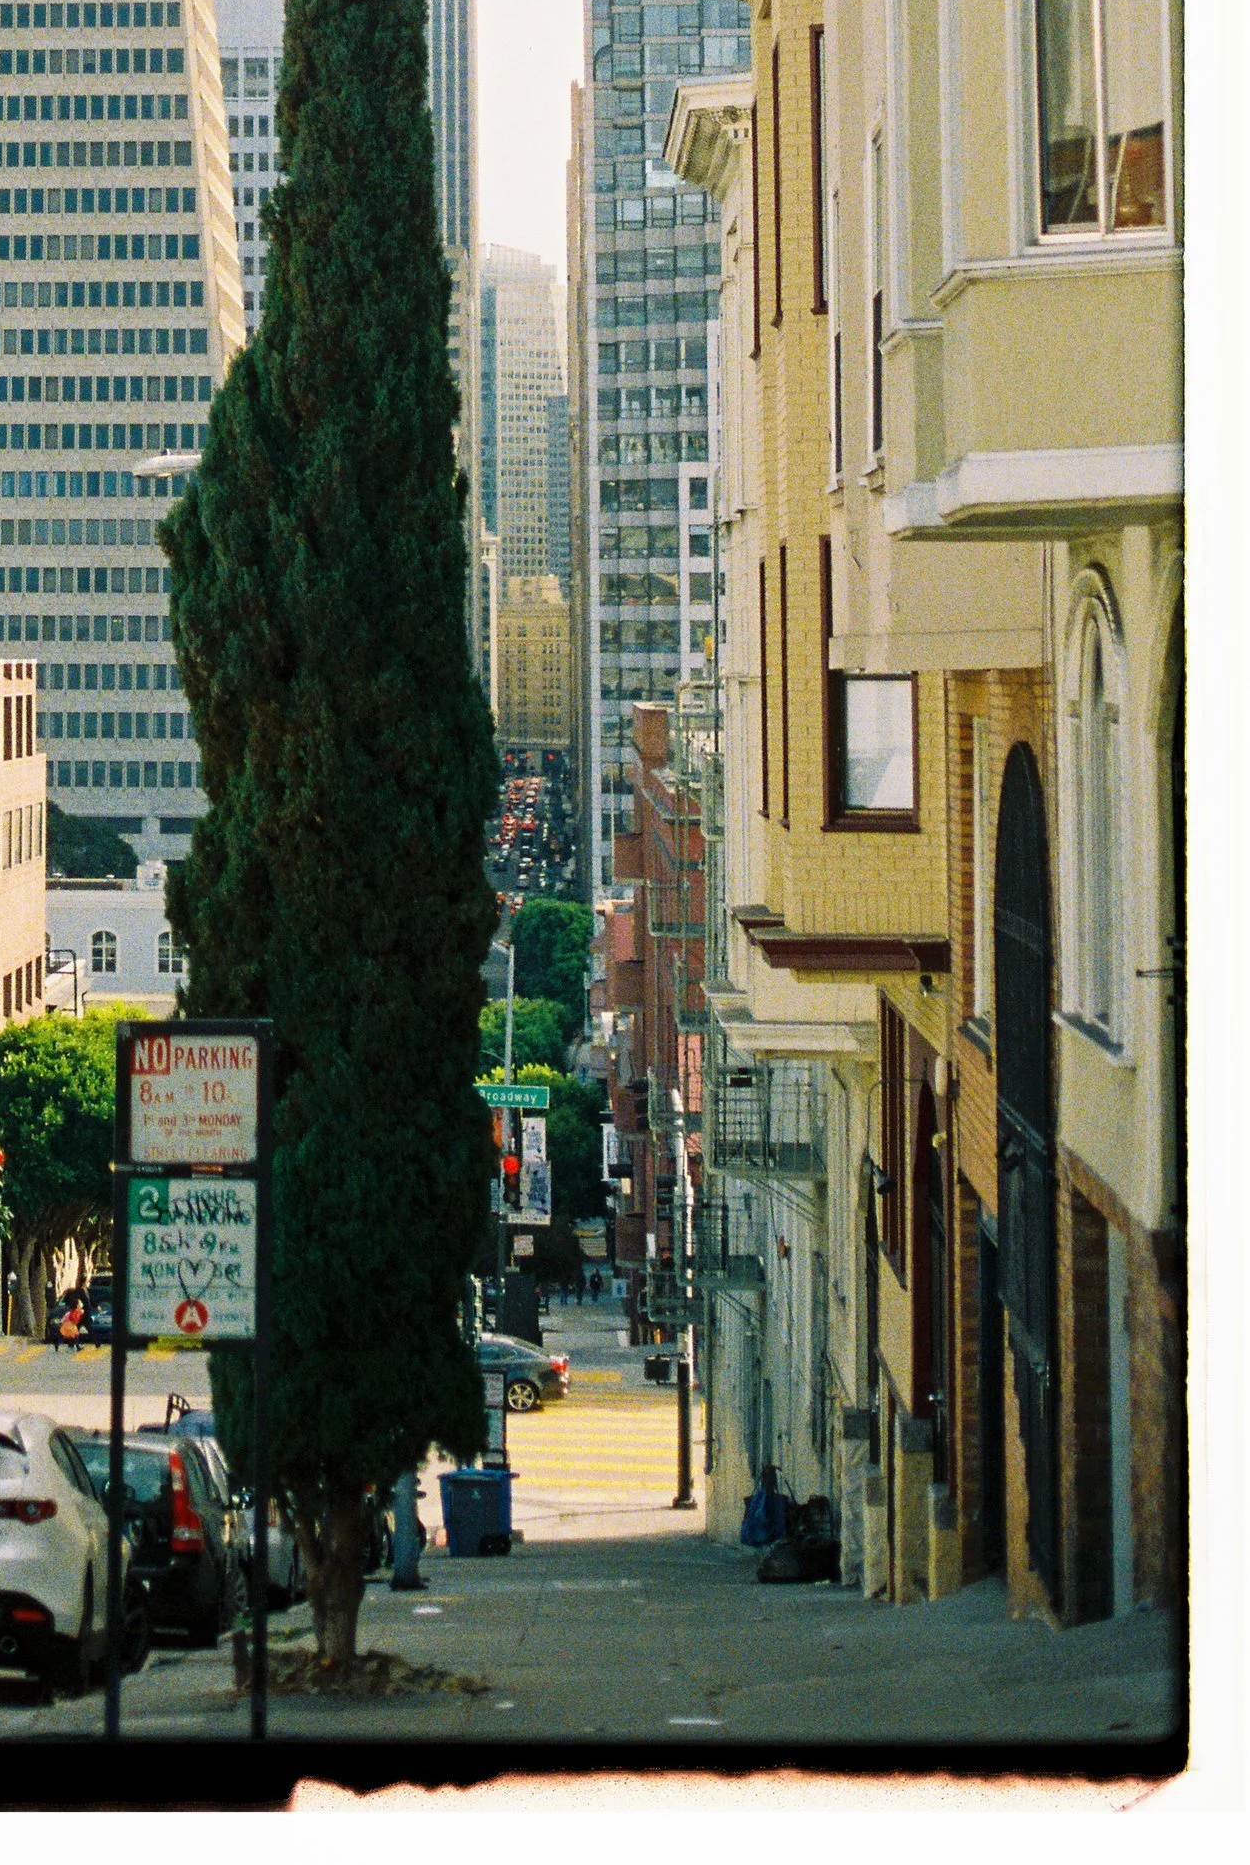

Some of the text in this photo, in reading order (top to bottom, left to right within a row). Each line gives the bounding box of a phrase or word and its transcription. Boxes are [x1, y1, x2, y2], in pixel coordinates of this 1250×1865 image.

[135, 1038, 252, 1071] NO PARKING
[197, 1113, 241, 1126] MONDAY
[139, 1185, 160, 1217] 2
